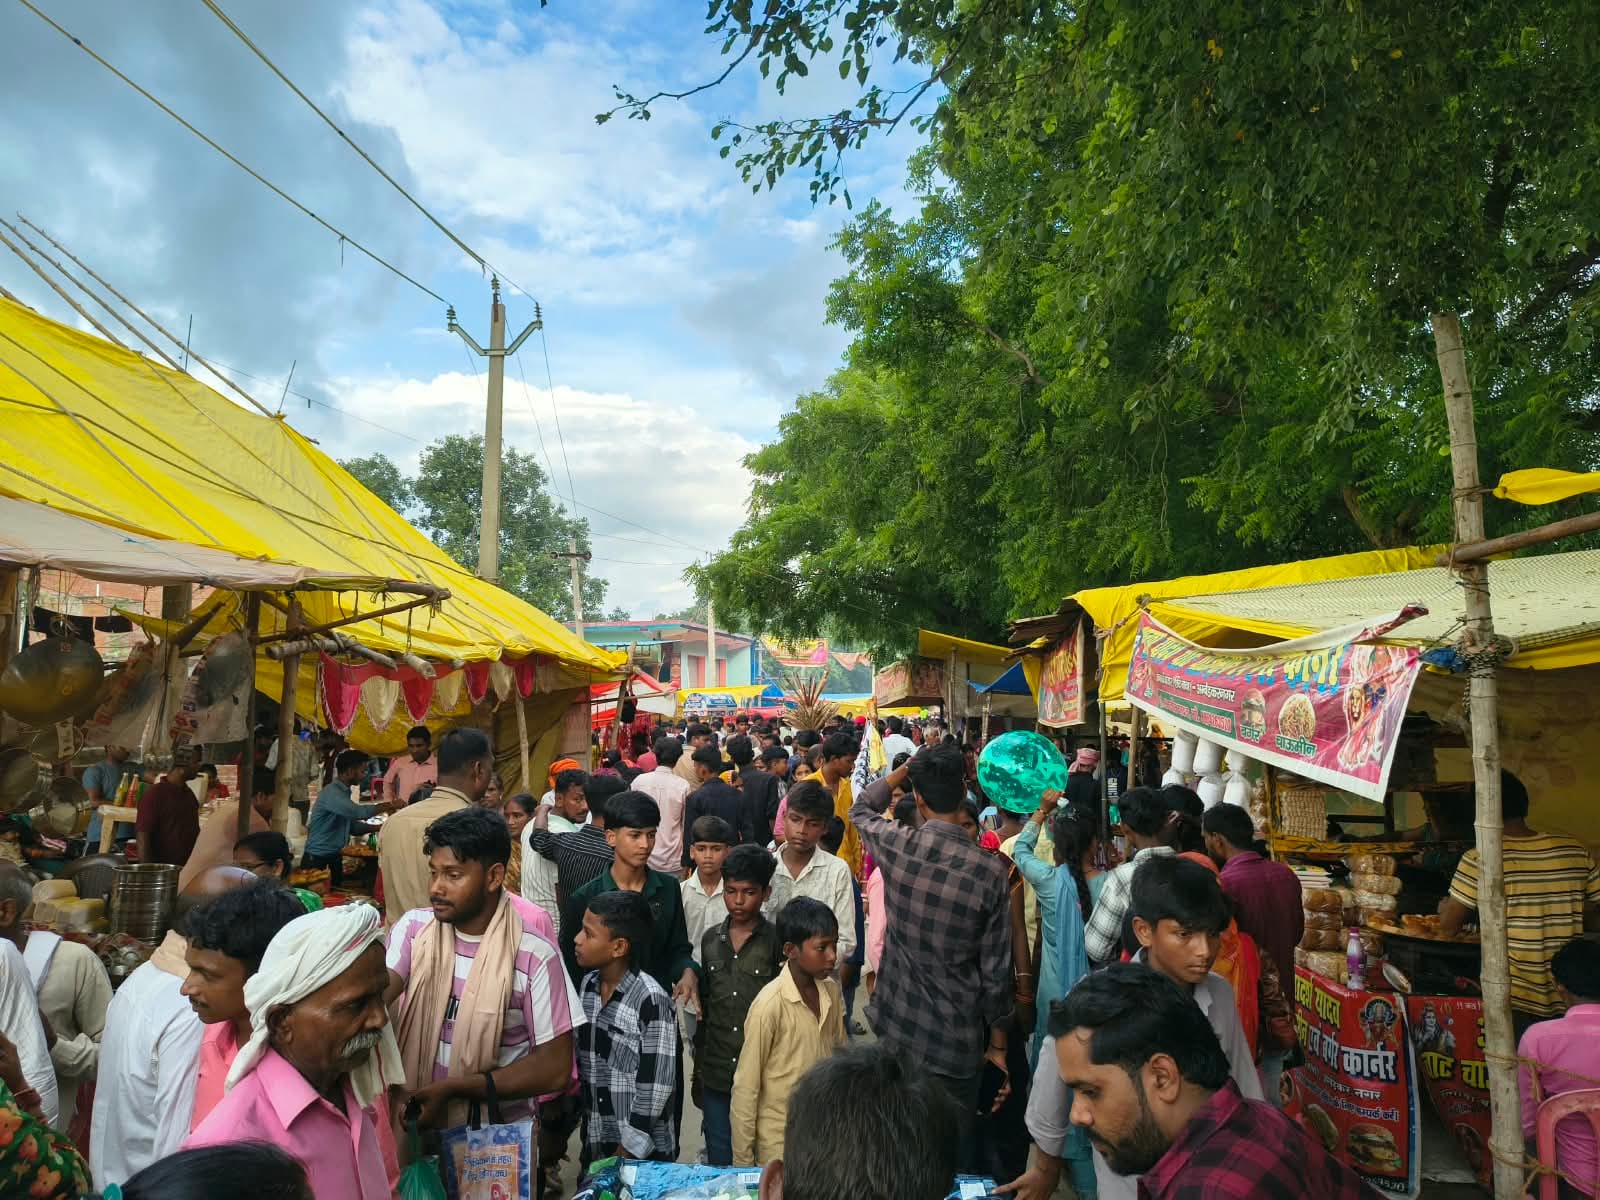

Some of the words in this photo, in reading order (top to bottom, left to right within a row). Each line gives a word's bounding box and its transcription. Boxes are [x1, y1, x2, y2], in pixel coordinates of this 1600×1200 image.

[1275, 734, 1317, 759] चाऊमीन
[1314, 986, 1341, 1029] यादव
[1353, 1087, 1382, 1101] नगर
